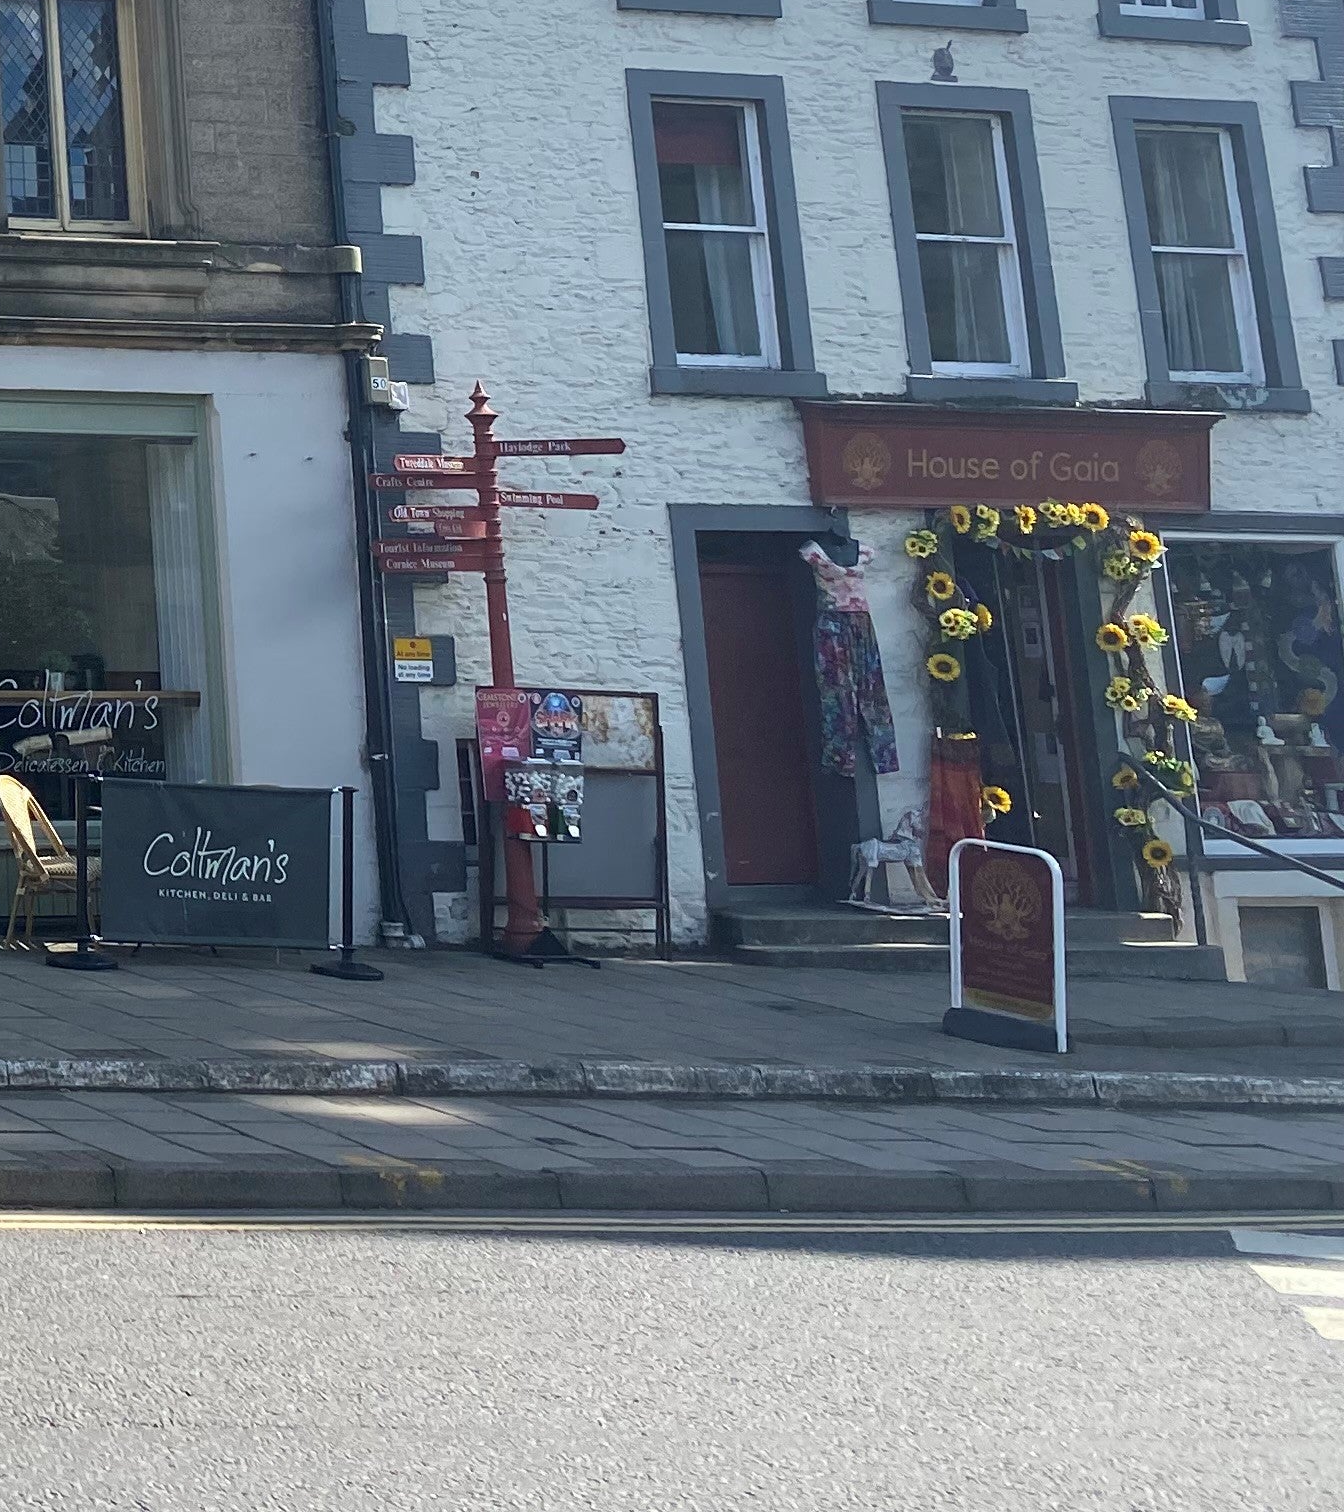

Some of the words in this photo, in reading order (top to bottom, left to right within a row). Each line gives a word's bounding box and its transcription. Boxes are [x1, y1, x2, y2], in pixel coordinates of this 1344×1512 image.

[372, 378, 387, 389] 50
[499, 442, 543, 454] Haylodge
[548, 441, 571, 452] Park
[907, 448, 1000, 480] House
[1009, 450, 1044, 481] of
[1049, 451, 1120, 482] Gaia
[375, 476, 403, 487] Crafts
[406, 476, 434, 487] Centre
[500, 491, 543, 505] Swimming
[546, 494, 564, 505] Pool
[393, 507, 407, 518] Old
[410, 507, 430, 518] Town
[432, 508, 465, 519] Shopping
[378, 542, 410, 553] Tourist
[412, 542, 463, 553] Information
[386, 558, 418, 569] Cornice
[420, 558, 456, 569] Museum
[112, 746, 165, 773] Kitchen
[143, 826, 289, 886] Coltman's
[158, 889, 211, 901] KITCHEN,
[213, 891, 238, 900] DELI
[241, 892, 249, 902] &
[252, 893, 272, 903] BAR
